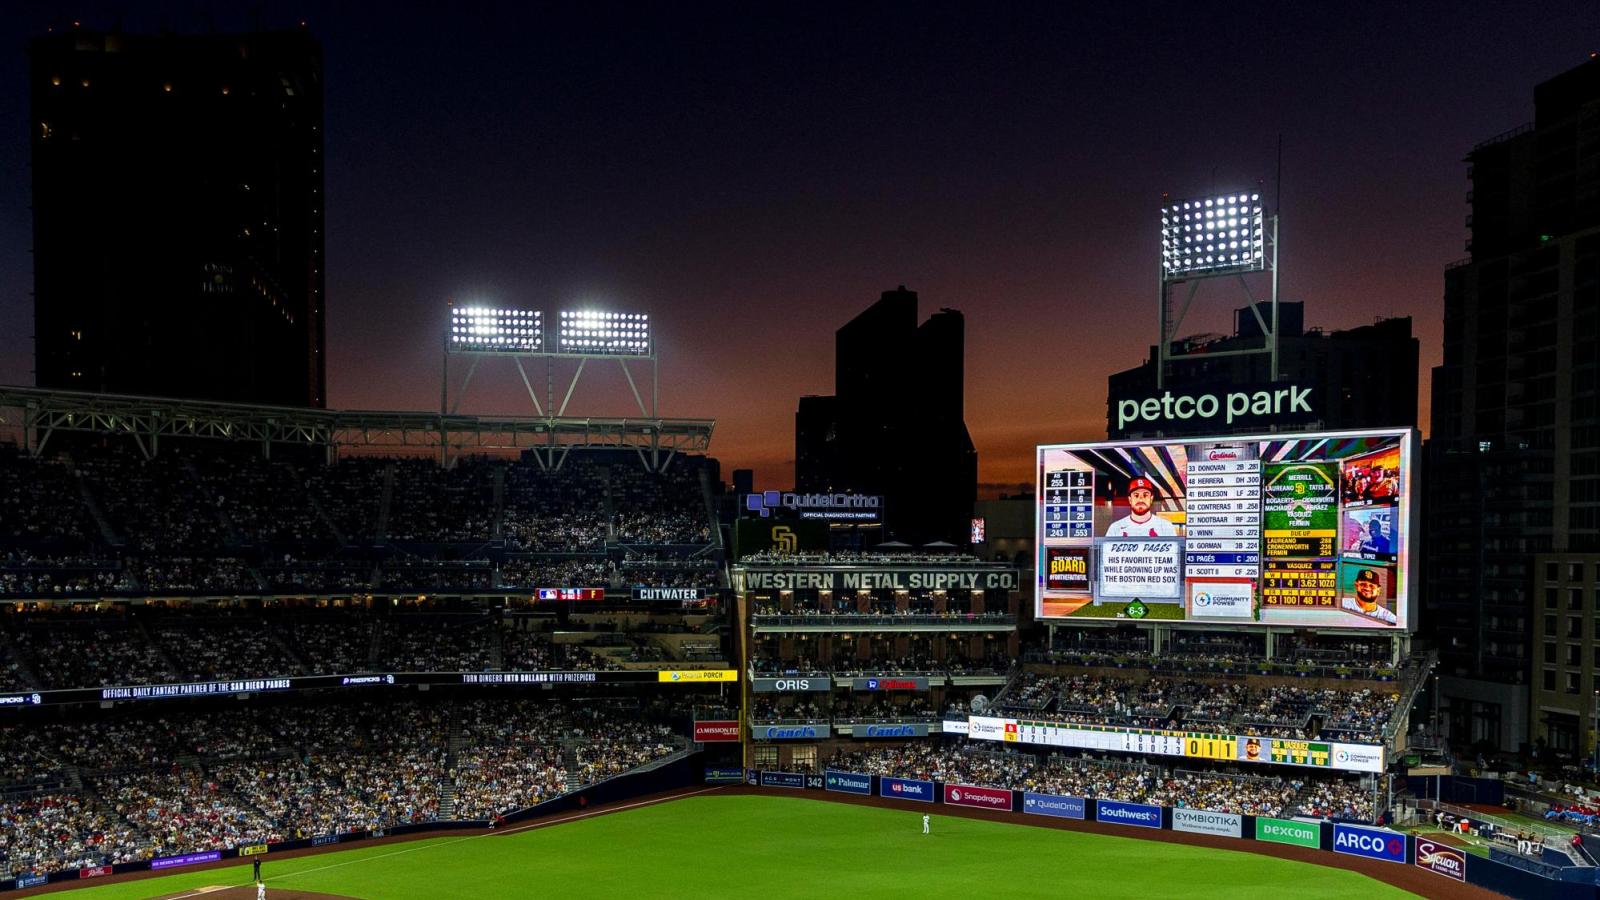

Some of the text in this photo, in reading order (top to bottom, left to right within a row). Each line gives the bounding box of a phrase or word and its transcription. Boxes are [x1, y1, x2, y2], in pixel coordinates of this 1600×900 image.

[1118, 385, 1312, 430] petco park
[783, 493, 878, 510] QuidelOrtho
[1111, 544, 1138, 552] PEDRO
[1051, 560, 1086, 574] BOARD
[747, 573, 834, 589] WESTERN
[843, 573, 903, 589] METAL
[909, 573, 980, 589] SUPPLY
[986, 573, 1017, 589] CO.
[640, 589, 697, 599] CUTWATER
[1128, 606, 1144, 614] 6-3
[102, 680, 290, 699] OFFICIAL DAILY FANTASY PARTNER OF THE SAN DIEGO PADRES
[775, 680, 809, 690] ORIS
[768, 726, 815, 737] Canel's
[867, 725, 914, 736] Canel's
[1191, 740, 1230, 757] 0 1 1
[808, 777, 822, 787] 342
[838, 777, 868, 789] Palomar
[903, 784, 923, 794] bank
[964, 792, 1006, 804] Snapdragon
[1037, 800, 1081, 812] QuidelOrtho
[1101, 806, 1150, 821] Southwest
[1175, 812, 1238, 826] CYMBIOTIKA
[1336, 832, 1384, 852] ARCO
[1419, 844, 1460, 870] Sycuan
